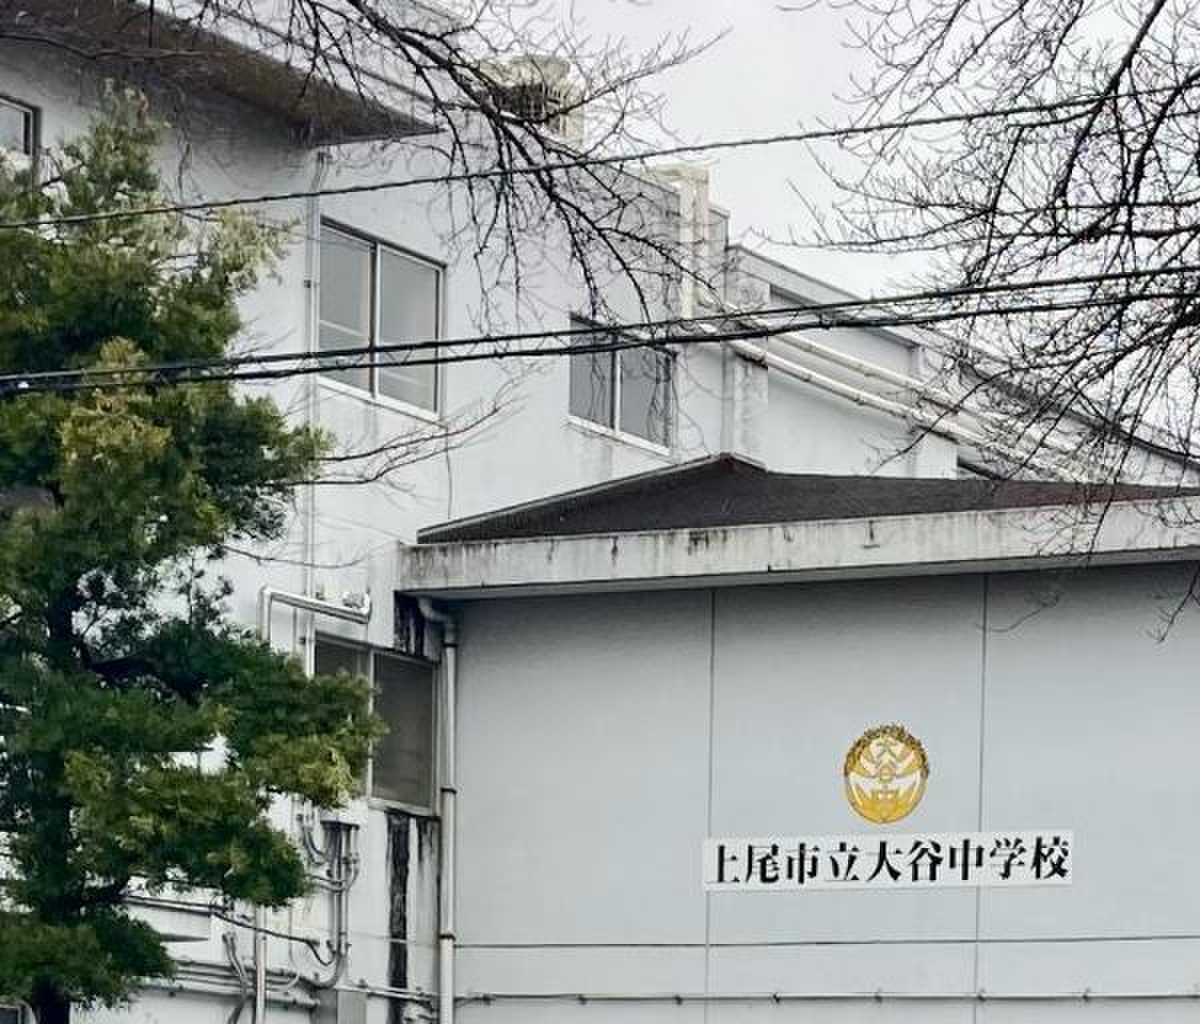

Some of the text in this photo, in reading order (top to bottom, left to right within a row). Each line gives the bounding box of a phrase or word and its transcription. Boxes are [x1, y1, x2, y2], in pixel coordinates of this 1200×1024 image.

[714, 835, 1070, 885] 上尾市立大谷中学校
